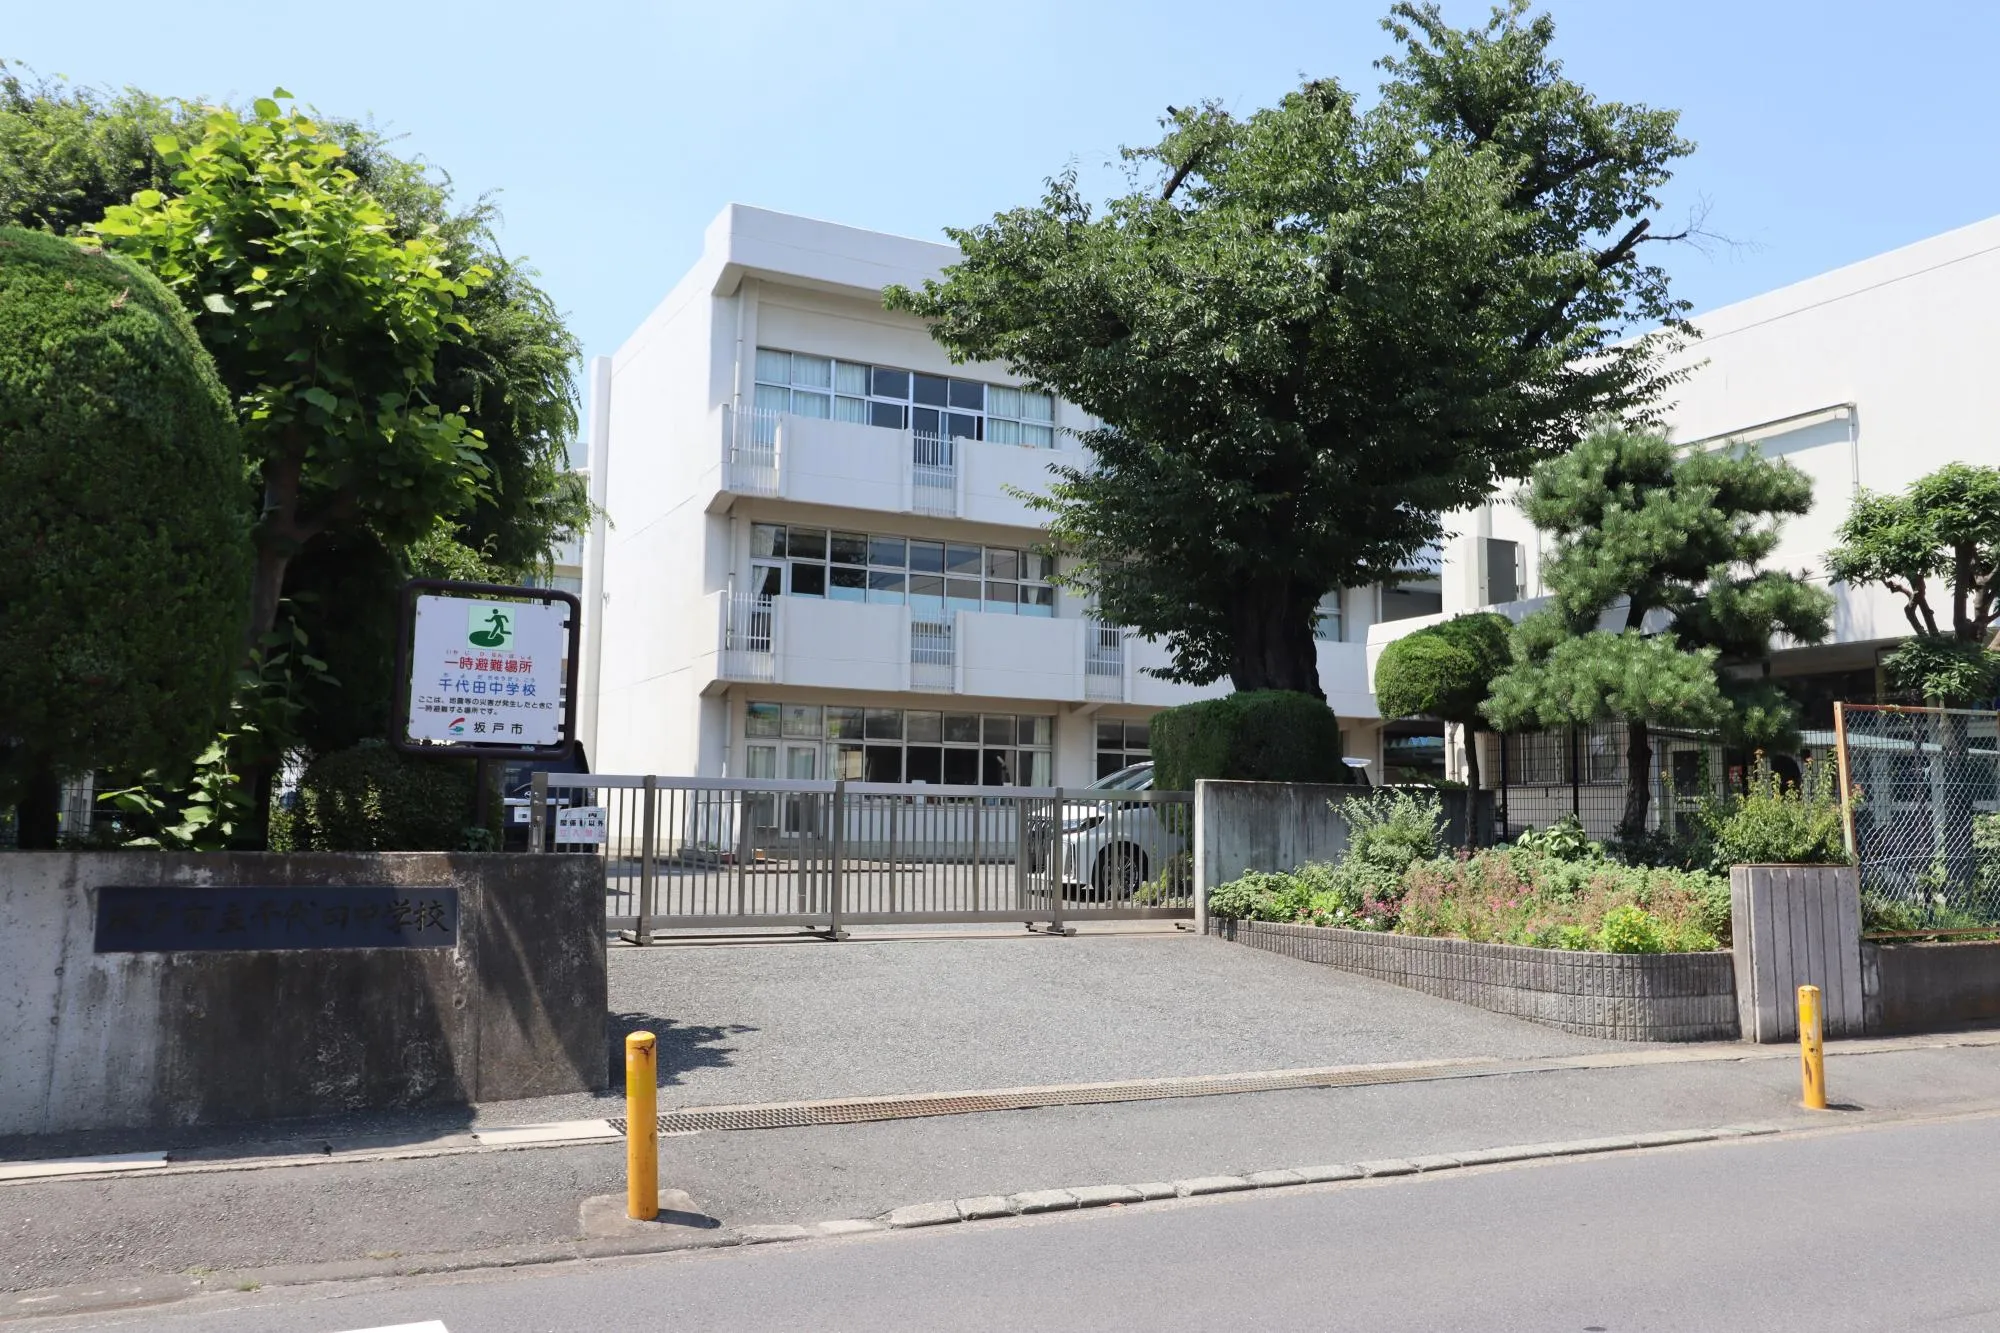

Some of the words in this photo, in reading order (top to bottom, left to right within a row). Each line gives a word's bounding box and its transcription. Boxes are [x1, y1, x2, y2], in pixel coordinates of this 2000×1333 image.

[444, 656, 532, 673] 一時避難場所
[439, 678, 536, 697] 千代田中学校
[474, 722, 523, 735] 坂戸市
